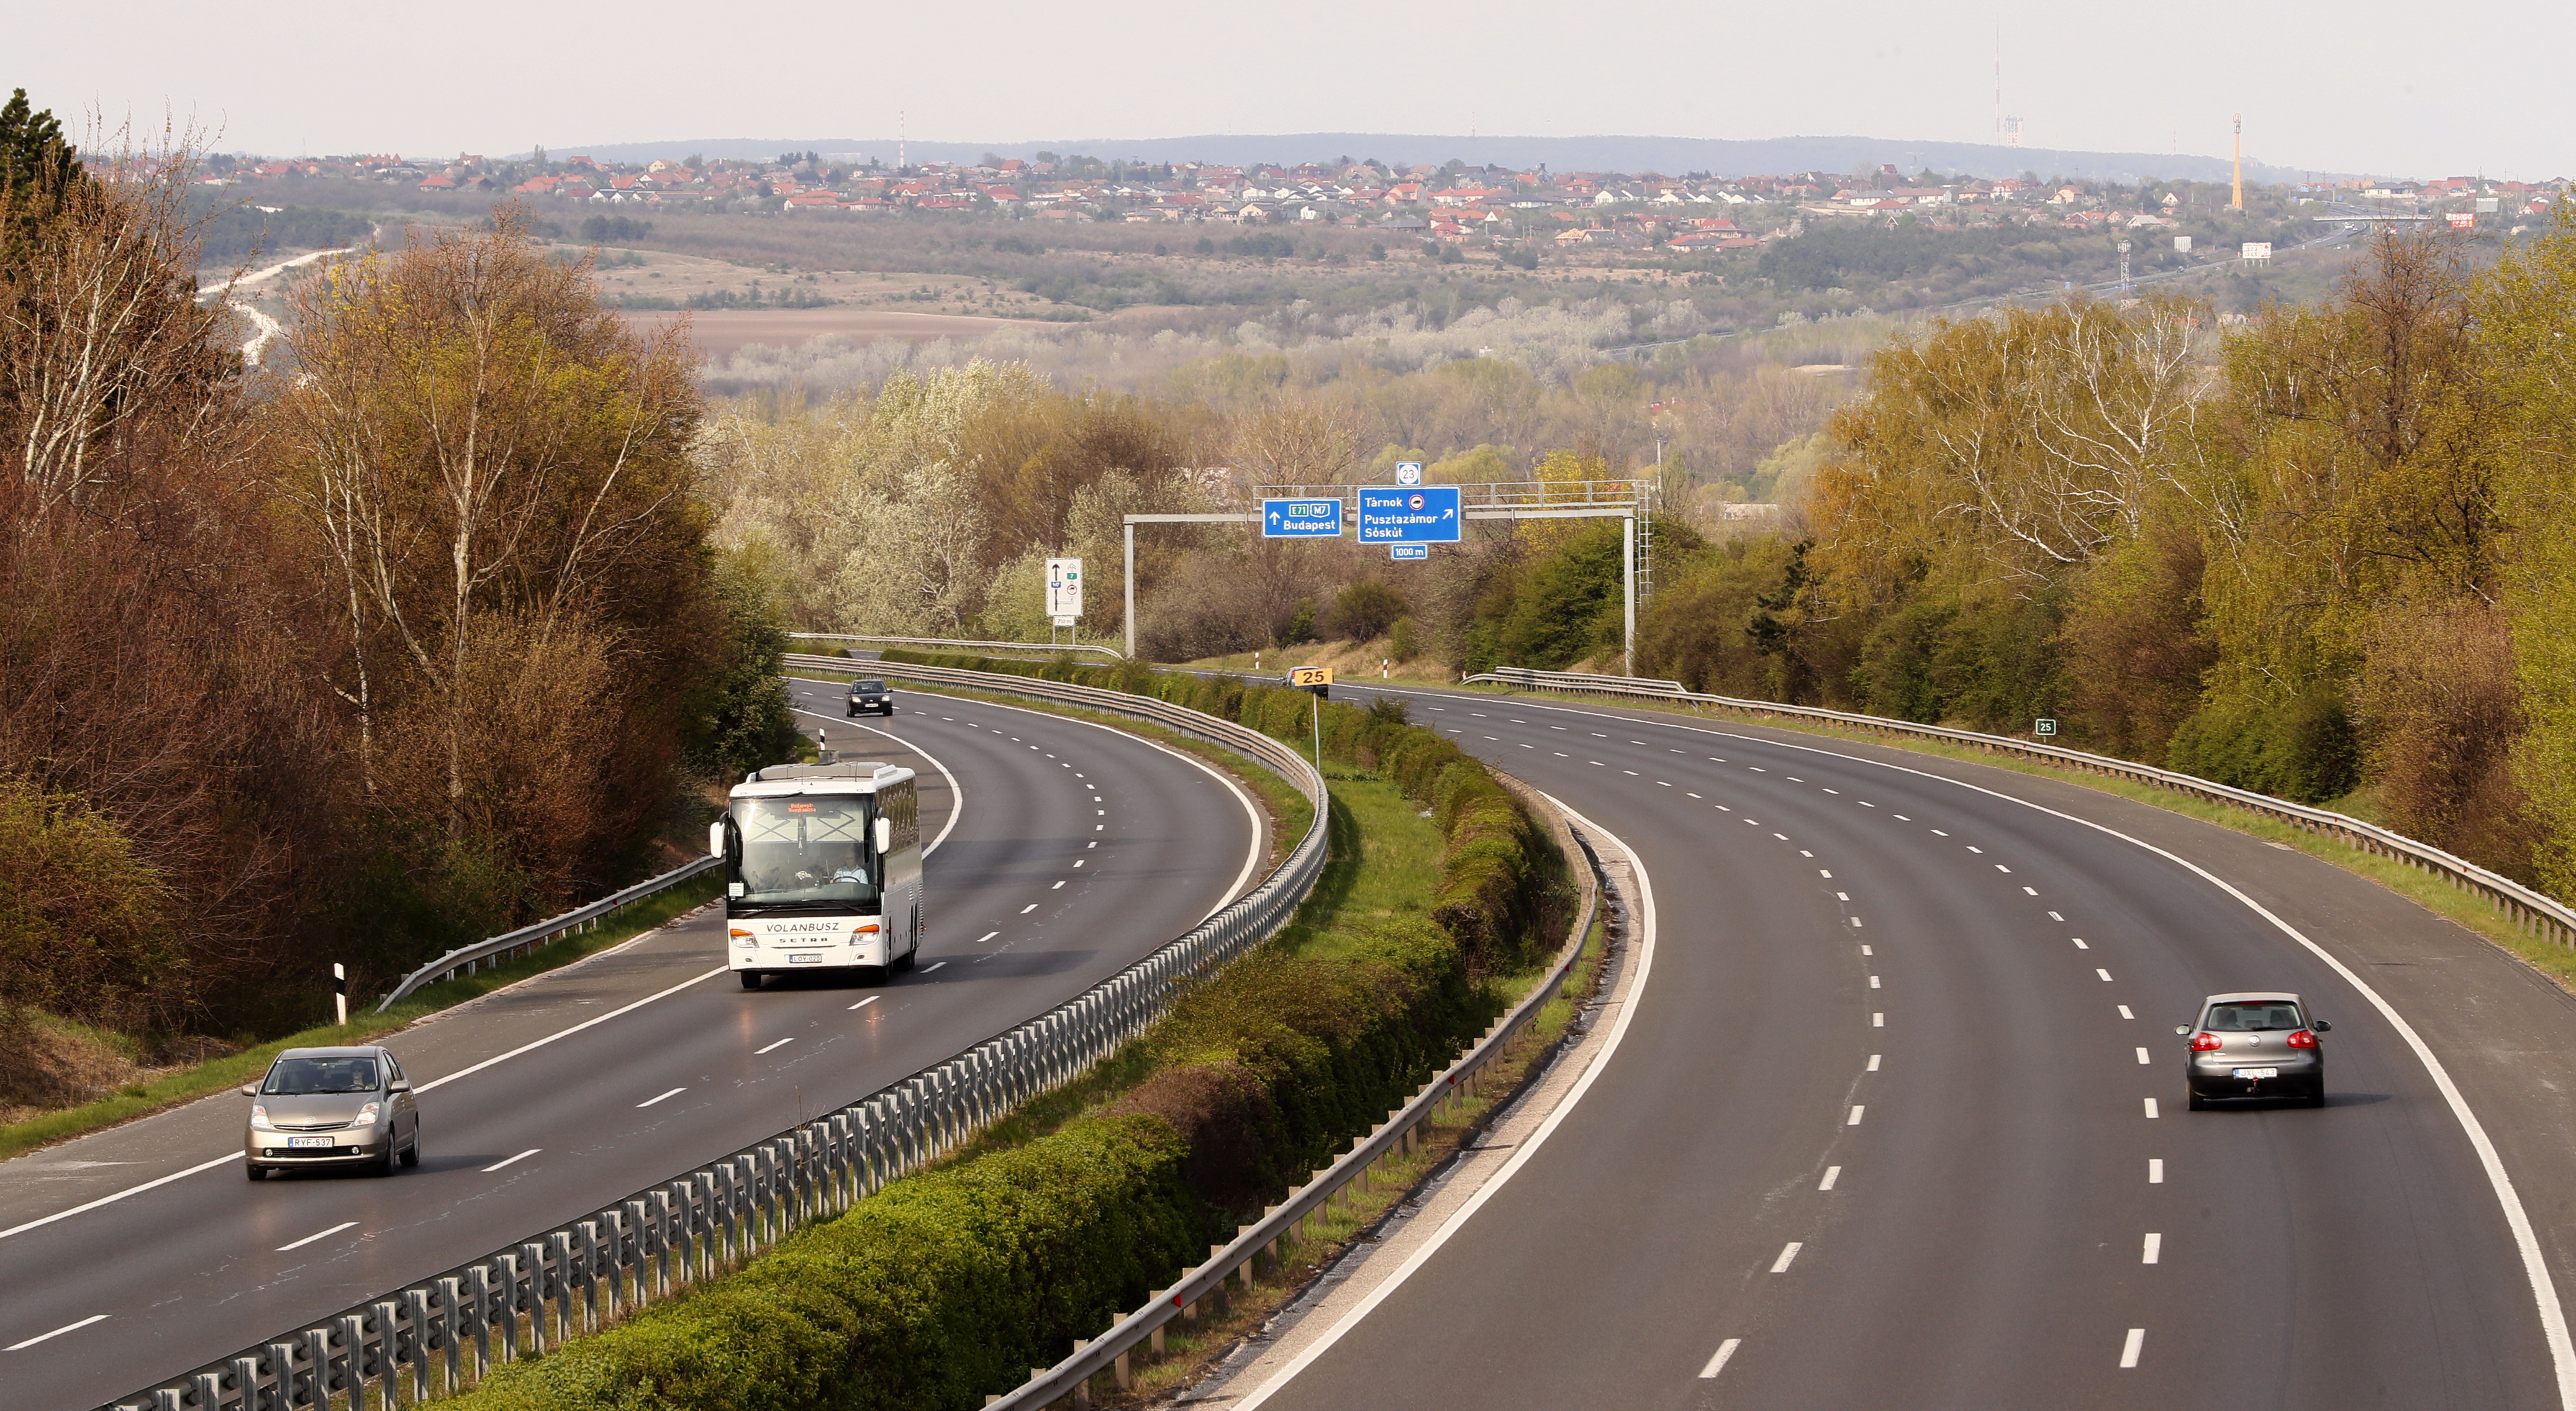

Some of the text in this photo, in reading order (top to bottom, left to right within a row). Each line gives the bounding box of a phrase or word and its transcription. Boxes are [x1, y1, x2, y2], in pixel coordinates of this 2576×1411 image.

[1403, 470, 1415, 479] 23
[1364, 497, 1402, 507] Tárnok
[1314, 506, 1326, 514] M7
[1365, 514, 1438, 524] Pusztazámor
[1284, 520, 1335, 532] Budapest
[1365, 527, 1403, 537] Sóskút
[1395, 548, 1413, 556] 1000
[1303, 671, 1324, 683] 25
[2040, 723, 2051, 732] 25
[294, 1138, 330, 1146] RYF-537
